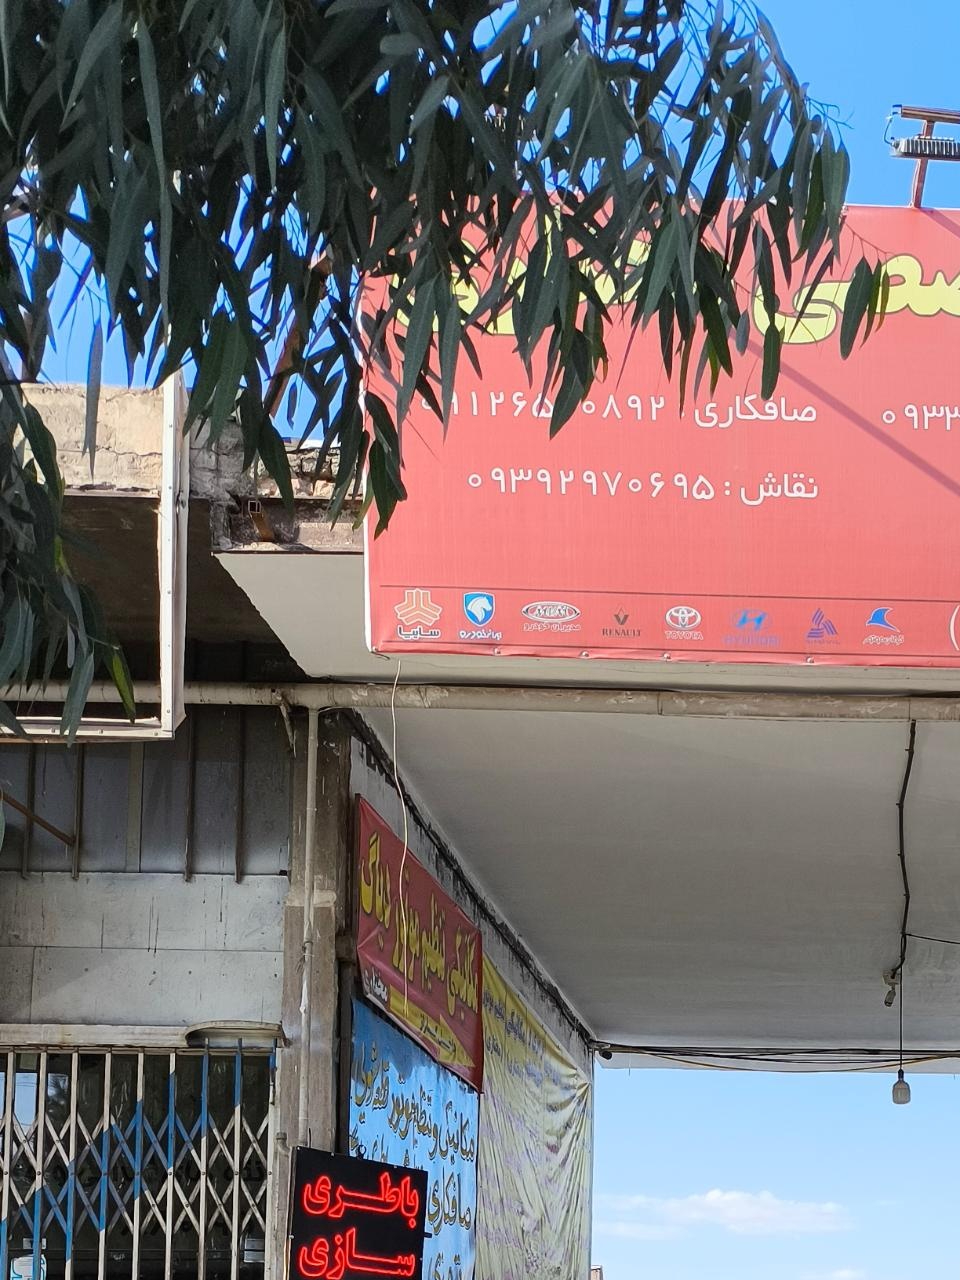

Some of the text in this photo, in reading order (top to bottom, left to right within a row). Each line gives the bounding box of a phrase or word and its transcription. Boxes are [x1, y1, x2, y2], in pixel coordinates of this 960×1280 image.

[695, 394, 818, 428] صافکاری
[466, 467, 715, 501] ۰۹۳۹۲۹۷۰۶۹۵
[397, 625, 441, 640] سایپا
[602, 628, 642, 639] RENAULT
[303, 1171, 420, 1230] باطری
